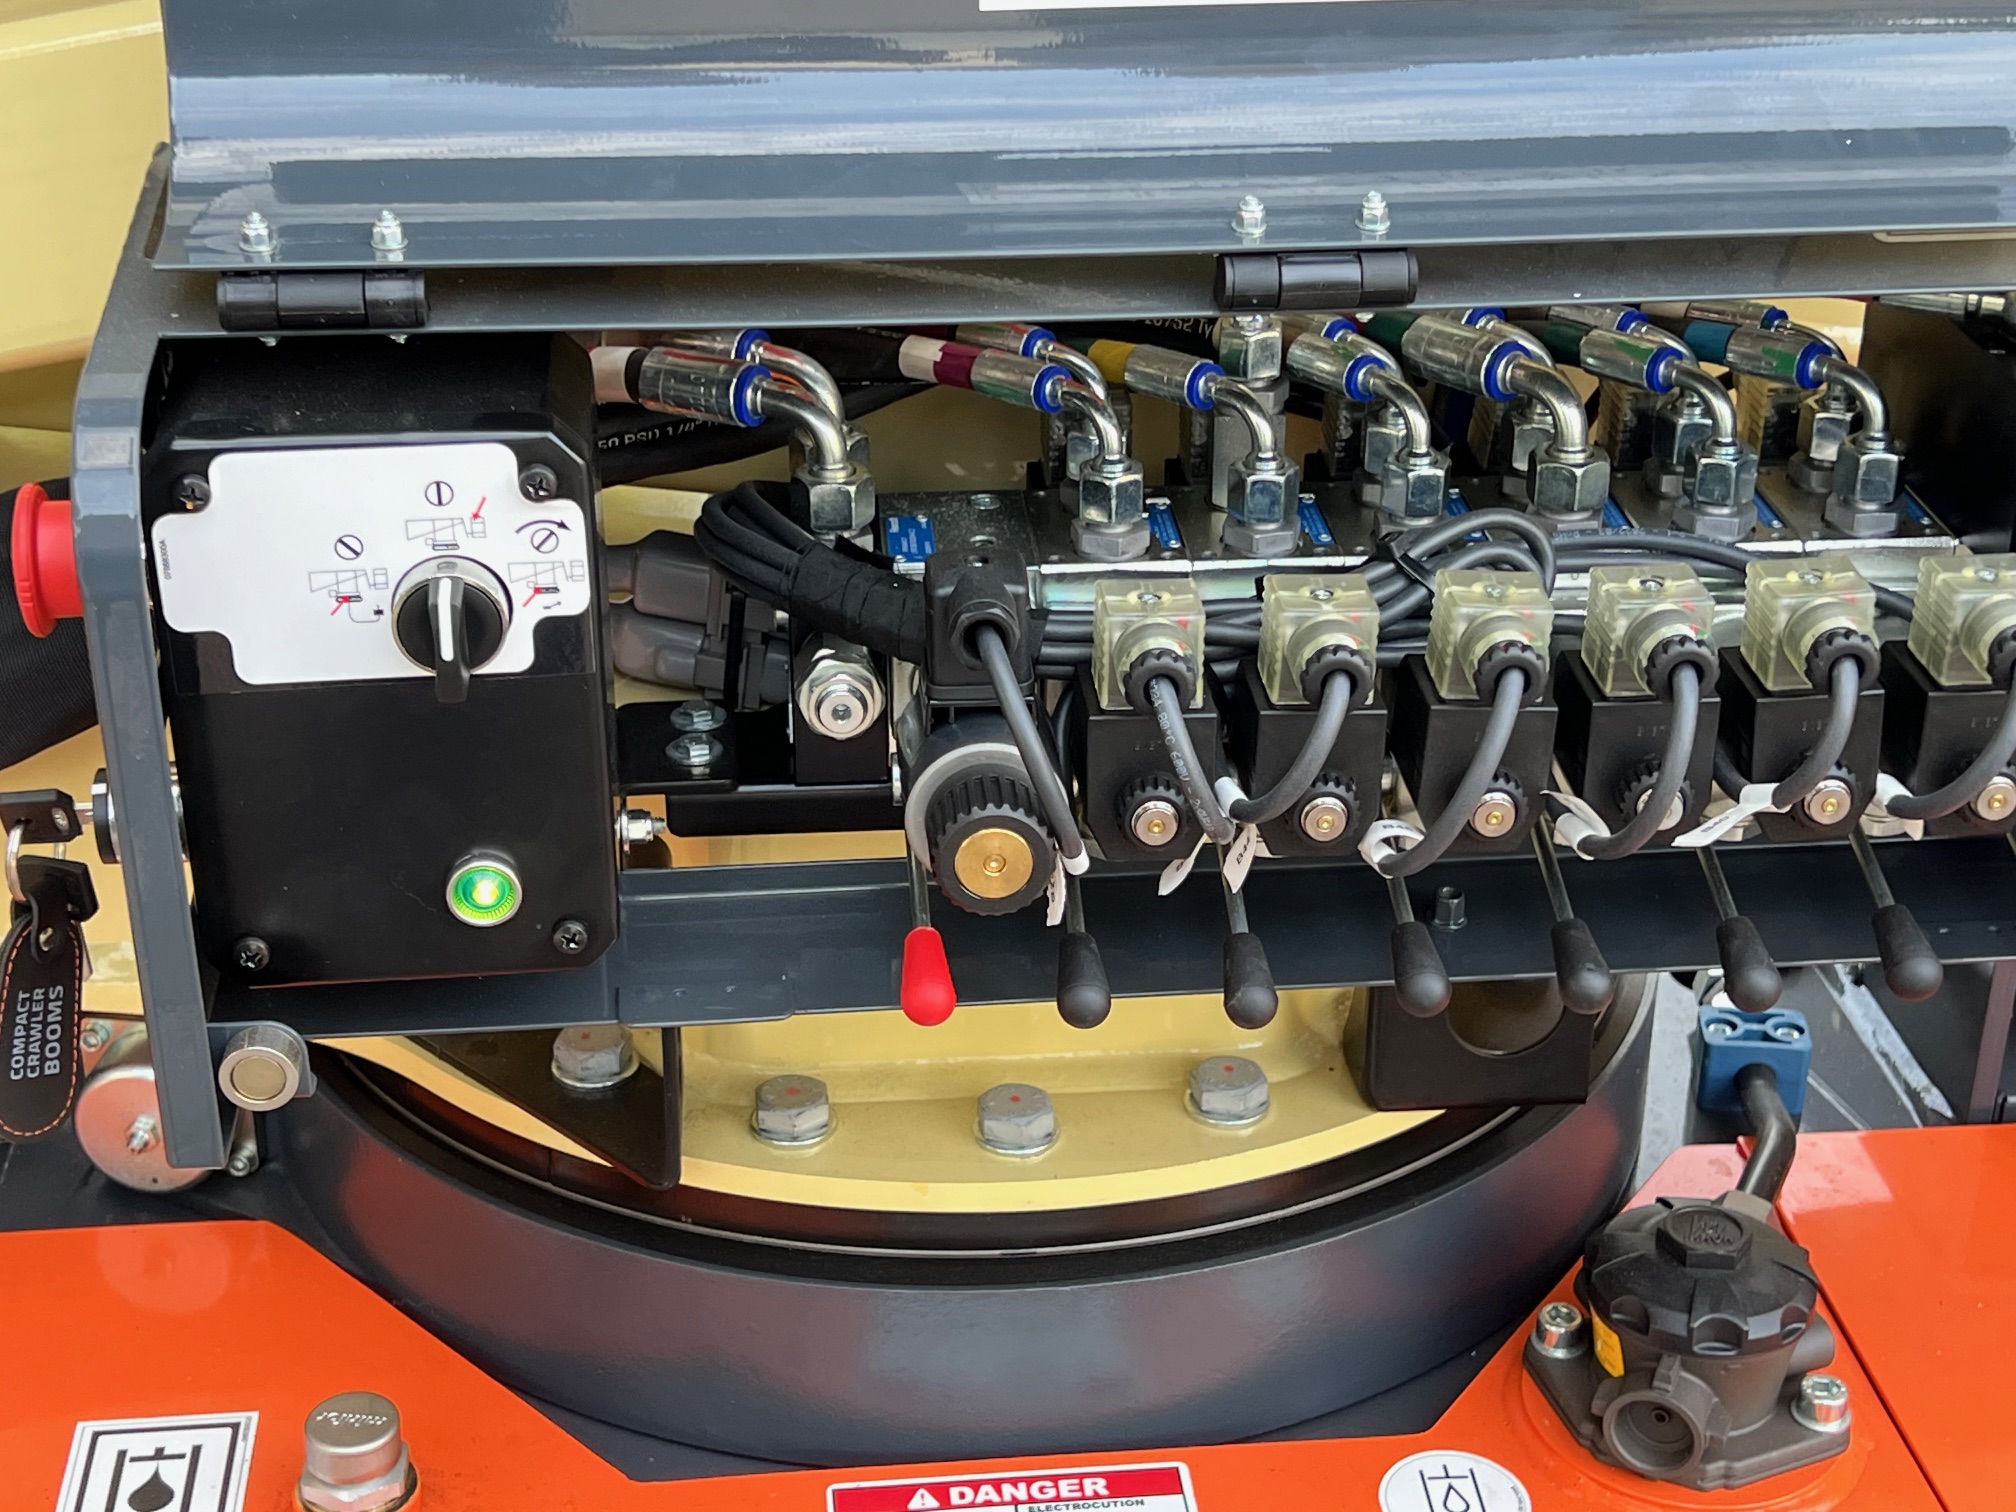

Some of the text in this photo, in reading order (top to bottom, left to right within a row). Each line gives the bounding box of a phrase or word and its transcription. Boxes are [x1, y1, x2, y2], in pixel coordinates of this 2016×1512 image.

[10, 989, 31, 1081] COMPACT
[26, 986, 46, 1079] CRAWLER
[43, 984, 65, 1076] BOOMS
[948, 1477, 1111, 1507] DANGER
[1027, 1498, 1147, 1512] ELECTROCUTION
